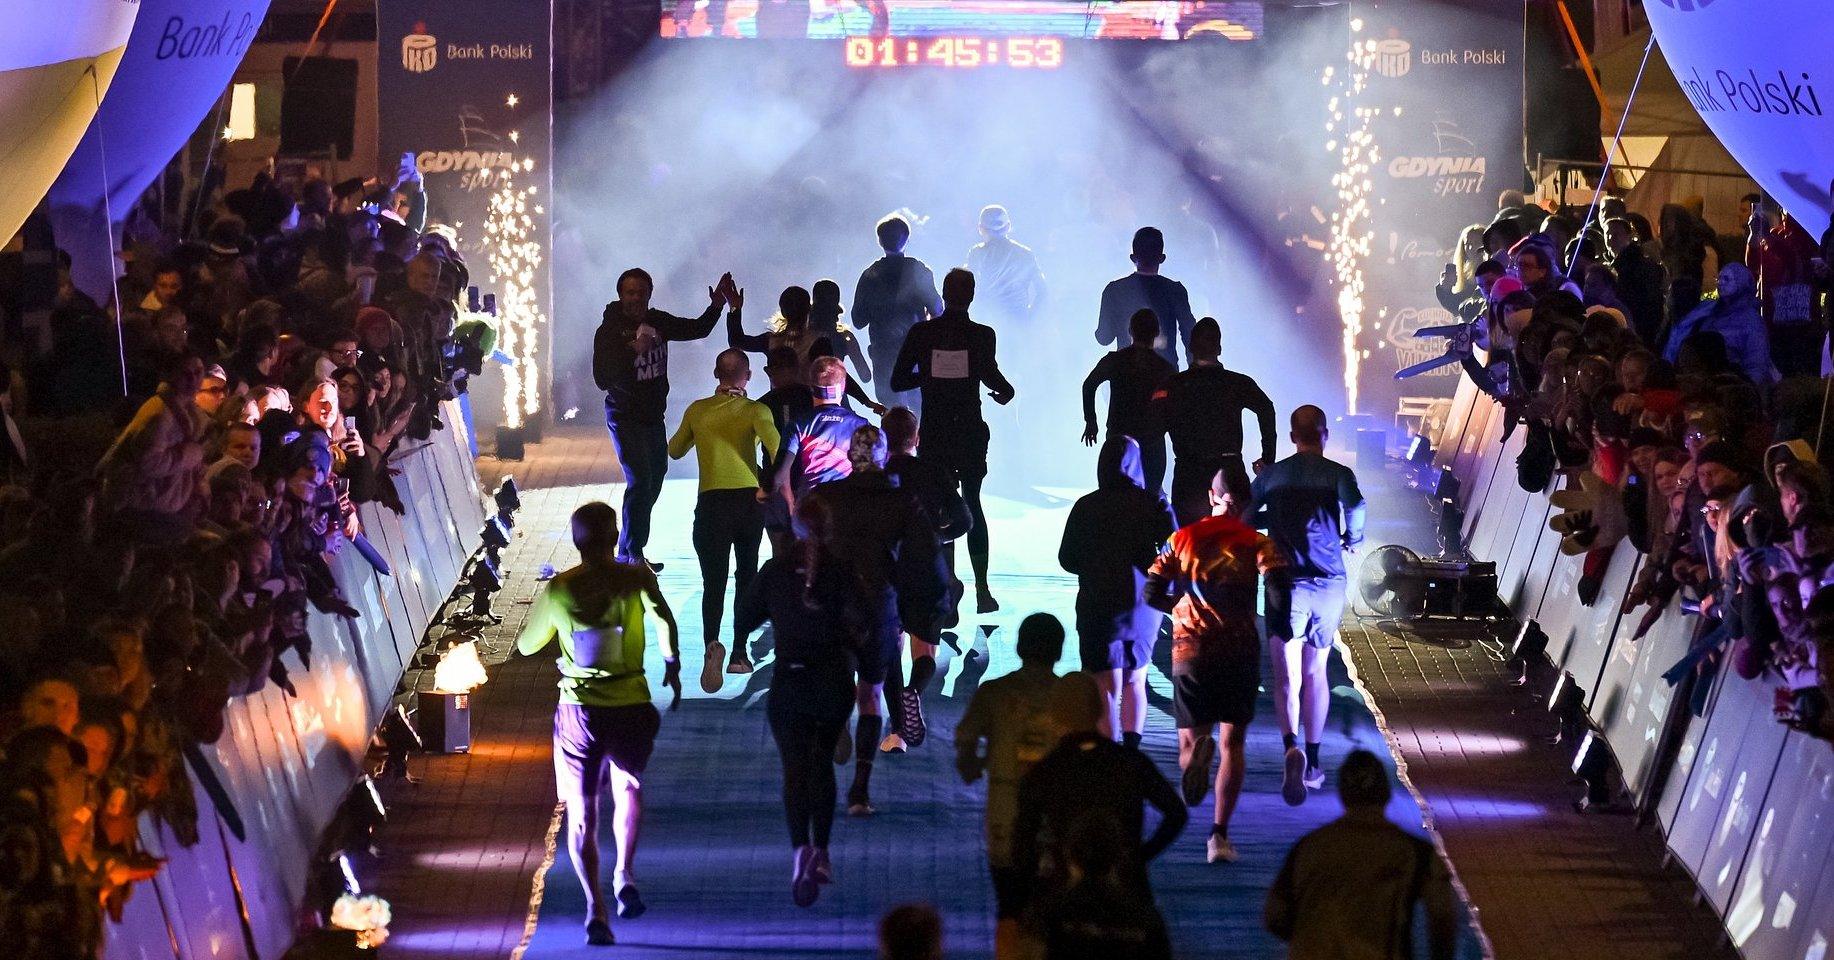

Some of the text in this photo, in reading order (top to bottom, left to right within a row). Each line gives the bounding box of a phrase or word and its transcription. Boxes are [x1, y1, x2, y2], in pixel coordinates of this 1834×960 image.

[156, 10, 230, 59] Bank
[447, 44, 484, 59] Bank
[491, 44, 533, 59] Polski
[846, 37, 1061, 67] 01:45:53
[1421, 49, 1458, 64] Bank
[1464, 49, 1506, 64] Polski
[1680, 66, 1823, 115] ank Polski
[416, 151, 512, 173] GDYNIA
[1388, 156, 1486, 178] GDYNIA
[460, 171, 507, 193] spor
[1434, 174, 1485, 197] sport
